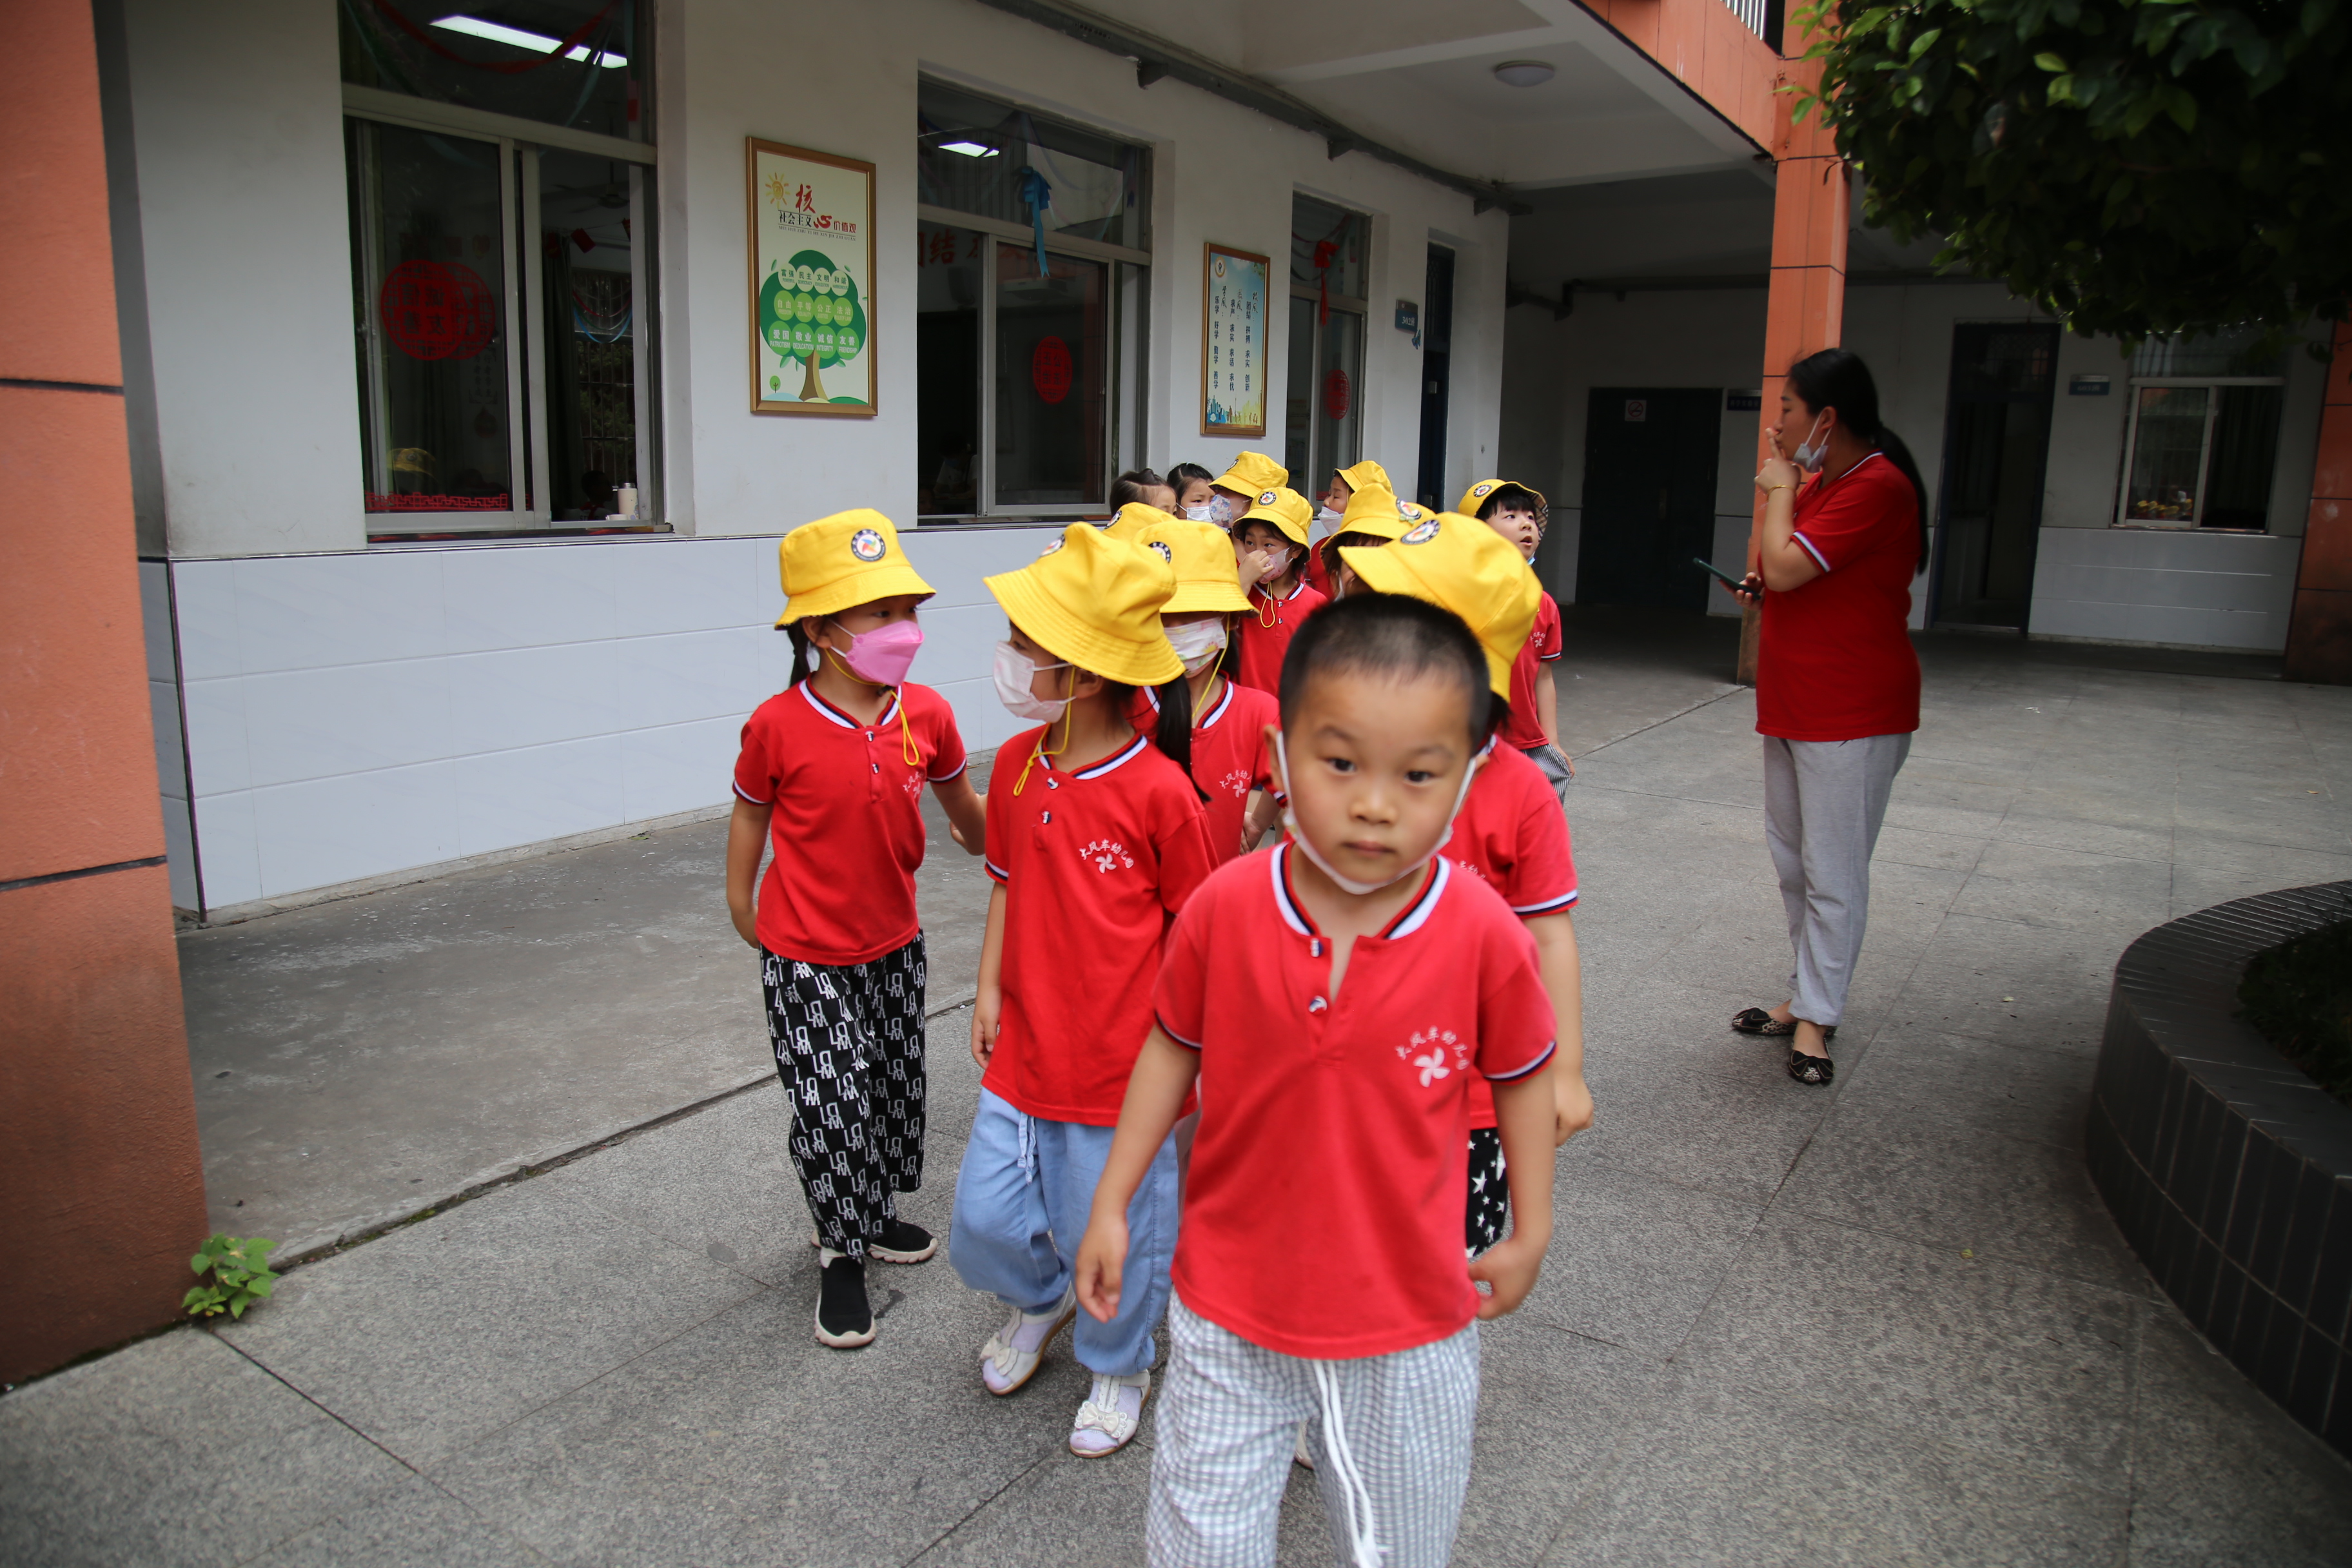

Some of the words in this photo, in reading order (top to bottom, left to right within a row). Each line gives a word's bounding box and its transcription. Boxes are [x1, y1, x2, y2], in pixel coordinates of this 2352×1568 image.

[796, 184, 816, 213] 核
[779, 211, 812, 228] 社会主义
[813, 215, 832, 229] 心
[834, 220, 856, 233] 价值观
[917, 228, 956, 267] 结
[781, 269, 794, 278] 富强
[799, 271, 812, 280] 民主
[817, 273, 829, 282] 文明
[834, 276, 847, 285] 和谐
[778, 299, 791, 309] 自由
[797, 301, 812, 311] 平等
[817, 304, 832, 313] 公正
[837, 306, 851, 316] 法治
[774, 329, 789, 340] 爱国
[796, 331, 812, 342] 敬业
[818, 334, 833, 344] 诚信
[839, 336, 855, 346] 友善
[1079, 838, 1135, 869] 大风车幼儿园
[1394, 1024, 1471, 1070] 大风车幼儿园
